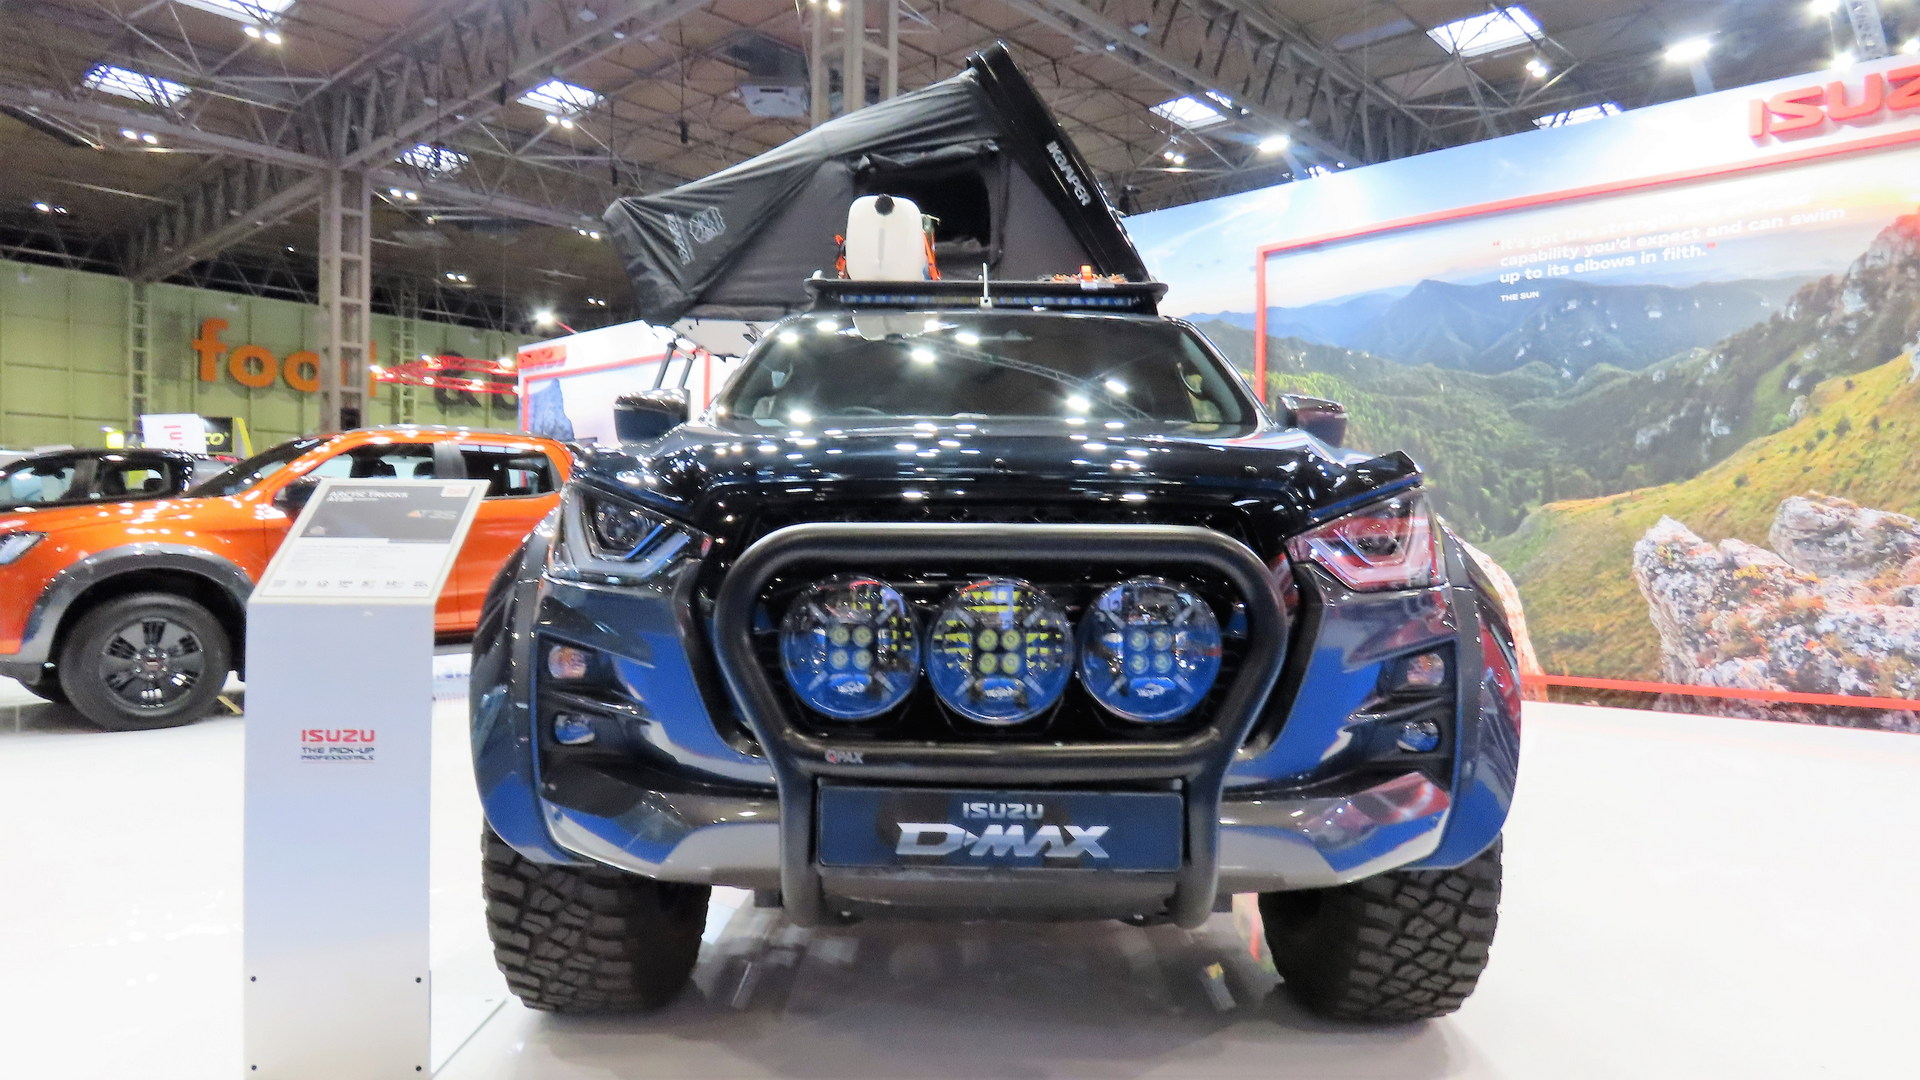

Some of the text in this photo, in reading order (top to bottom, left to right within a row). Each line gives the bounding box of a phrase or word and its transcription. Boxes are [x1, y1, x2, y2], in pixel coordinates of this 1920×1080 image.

[1500, 247, 1580, 268] capability
[1636, 227, 1700, 248] expect
[1706, 219, 1742, 237] and
[1747, 216, 1784, 232] can
[1789, 207, 1846, 226] swim
[1564, 226, 1593, 240] the
[1500, 270, 1521, 285] up
[1524, 267, 1543, 280] to
[1547, 263, 1570, 277] its
[1573, 254, 1636, 274] elbows
[1640, 250, 1657, 265] in
[1500, 290, 1540, 303] THE SUN
[301, 729, 375, 743] ISUZU
[301, 746, 324, 754] THE
[962, 802, 1044, 820] ISUZU
